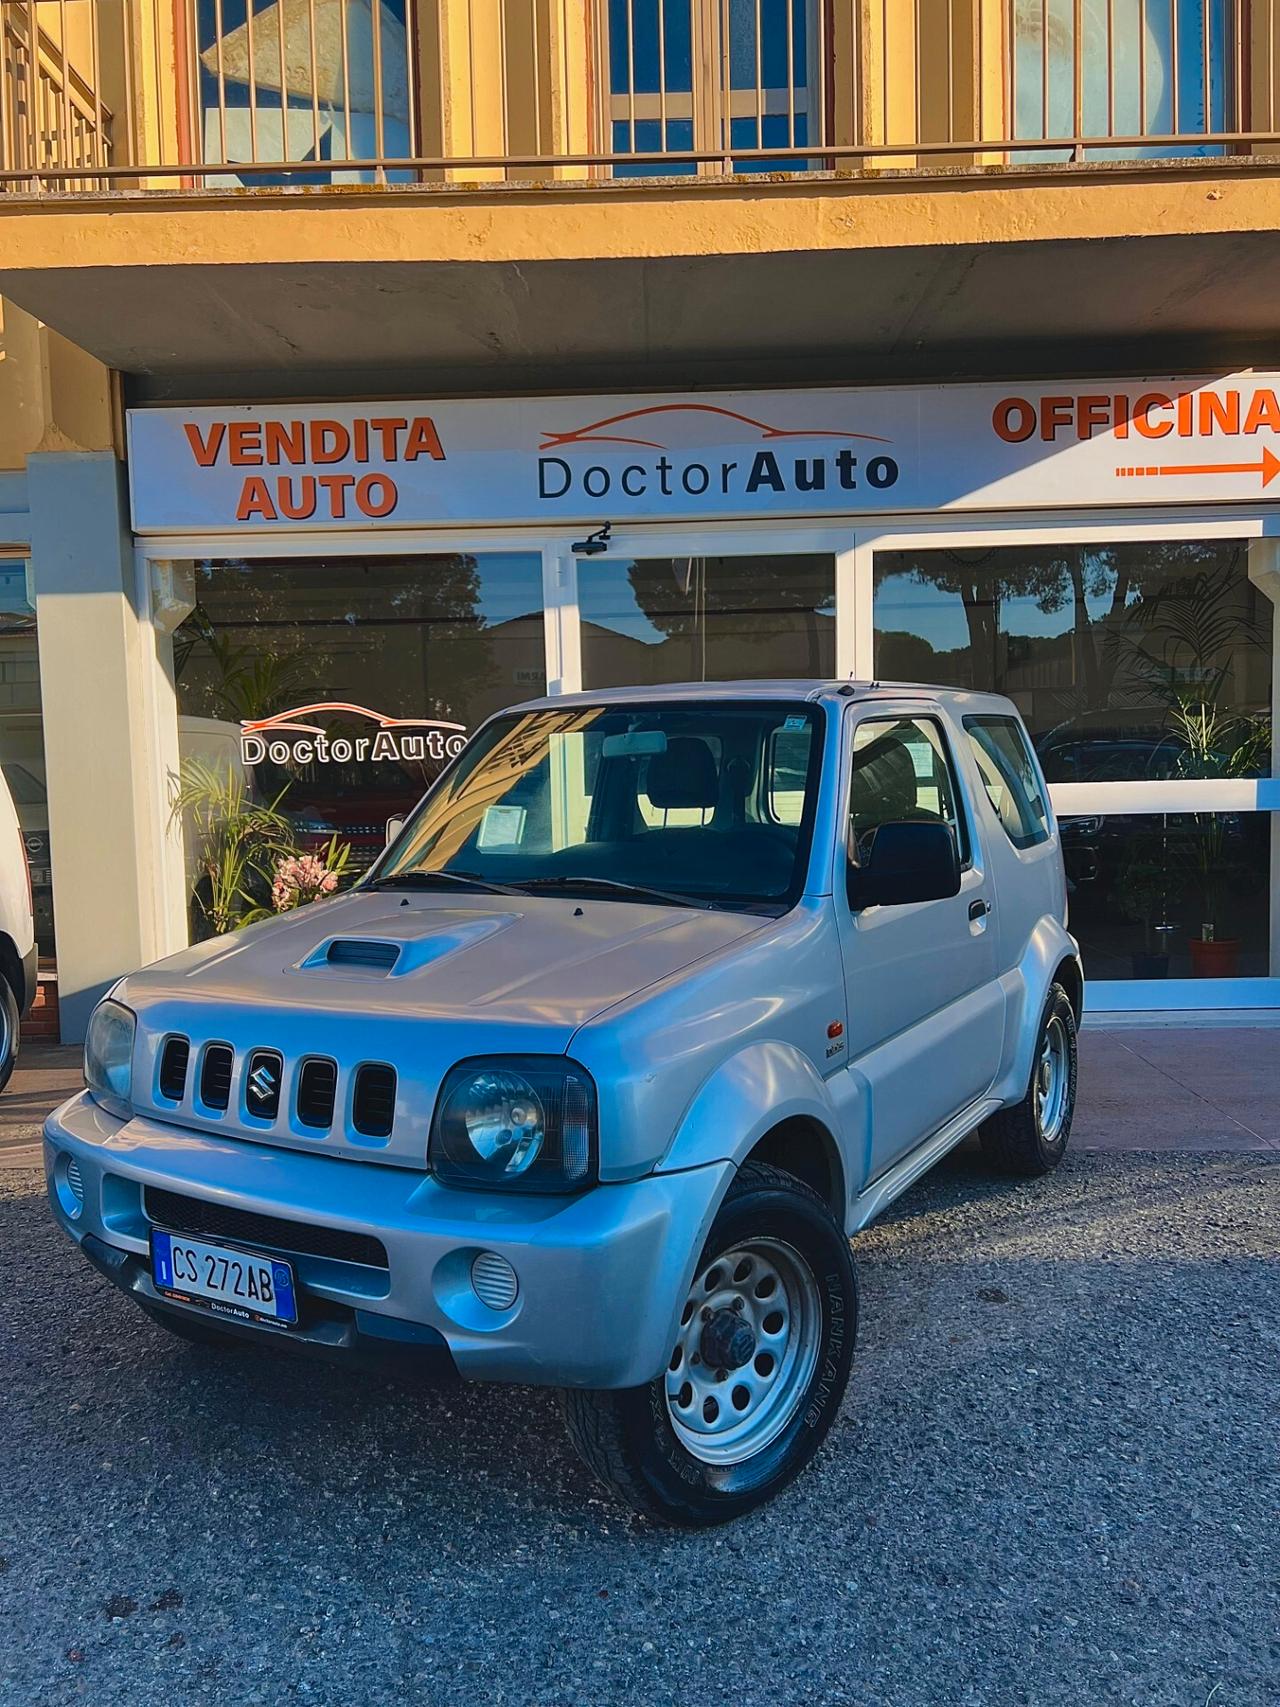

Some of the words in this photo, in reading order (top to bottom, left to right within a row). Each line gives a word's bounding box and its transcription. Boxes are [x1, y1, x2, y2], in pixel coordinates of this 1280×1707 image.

[992, 389, 1280, 443] OFFICINA
[184, 417, 446, 467] VENDITA
[236, 473, 398, 520] AUTO
[538, 449, 899, 499] DoctorAuto
[241, 729, 467, 766] DoctorAuto
[173, 1246, 198, 1283] CS
[211, 1302, 250, 1319] DoctorAuto
[804, 1273, 845, 1428] NANKANG
